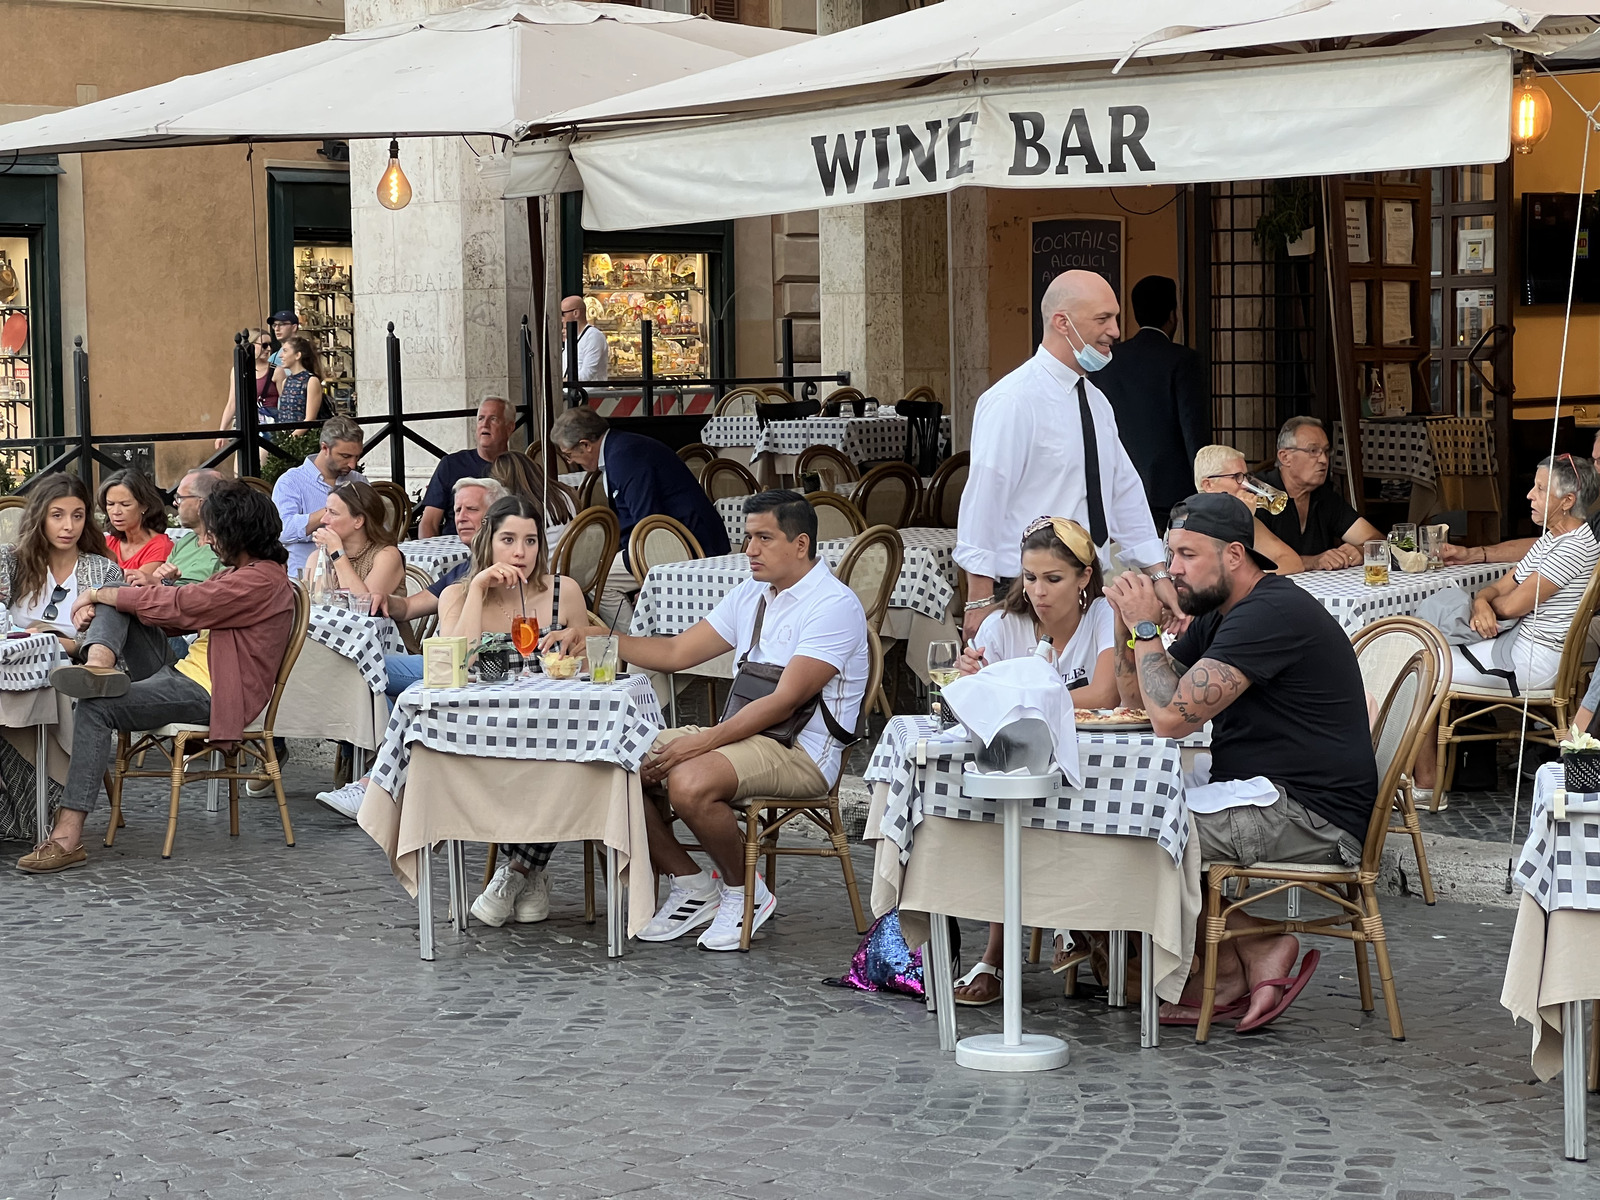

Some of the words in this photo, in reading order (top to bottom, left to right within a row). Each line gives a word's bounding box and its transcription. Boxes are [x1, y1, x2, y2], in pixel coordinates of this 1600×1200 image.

[811, 111, 979, 197] WINE
[1007, 105, 1156, 176] BAR
[1033, 230, 1119, 254] COCKTAILS
[1051, 254, 1105, 268] ALCOLICI
